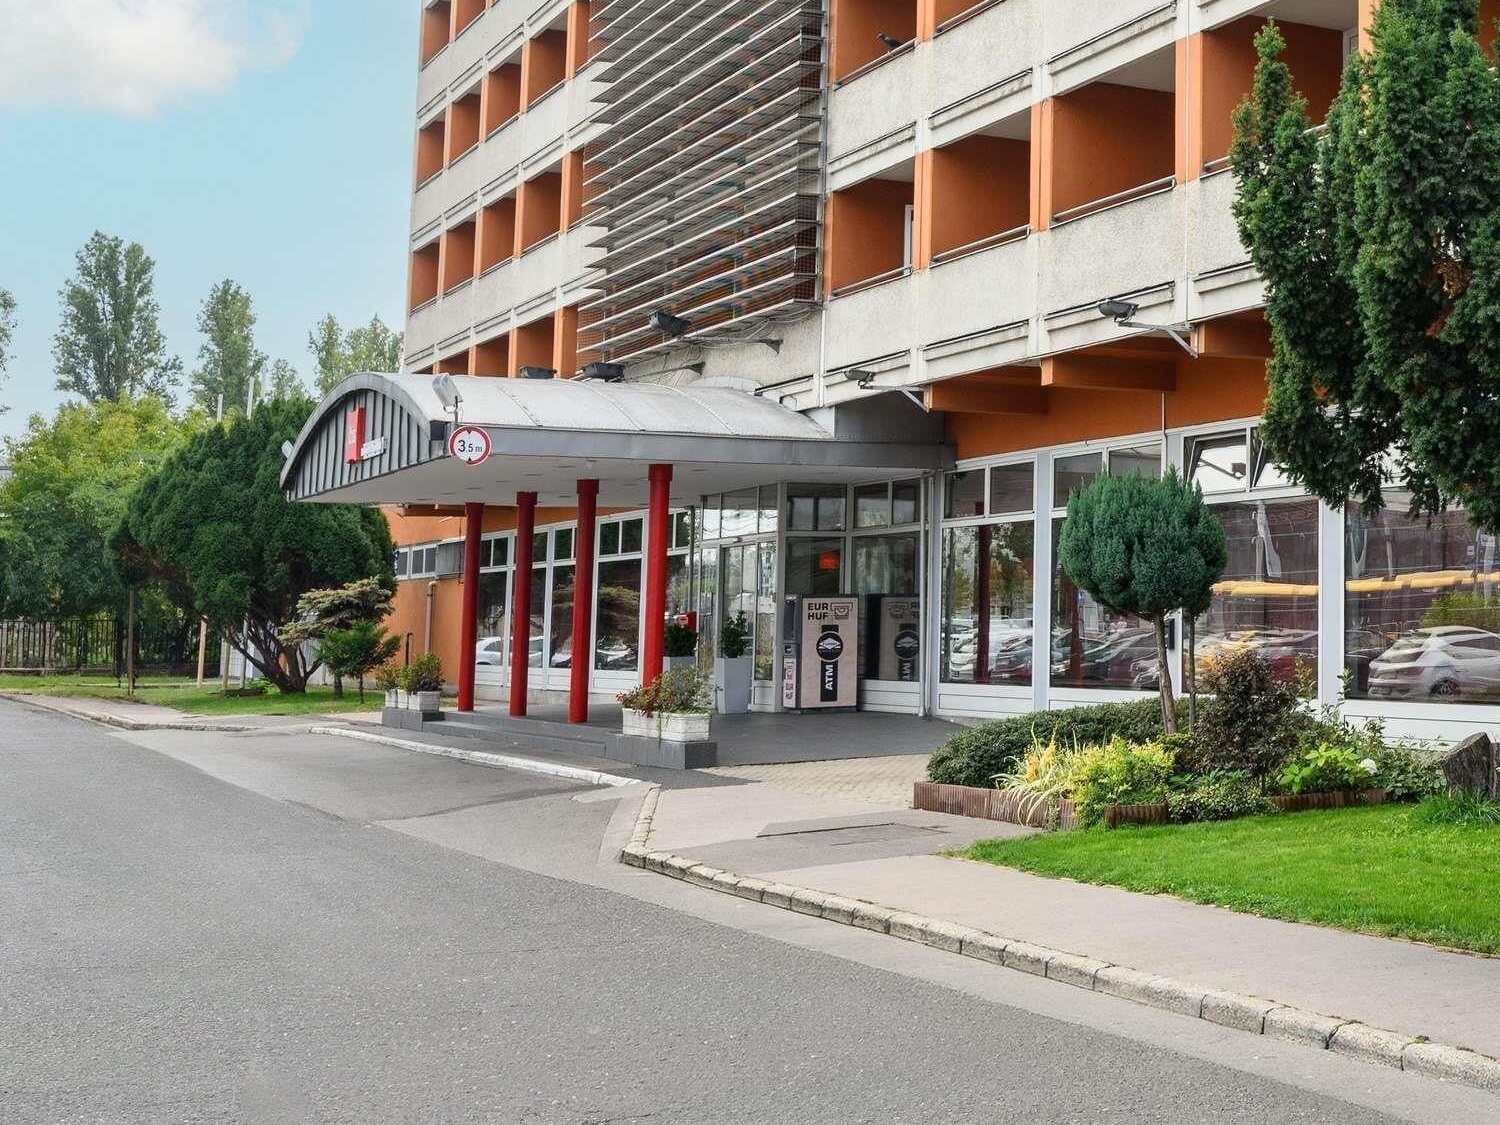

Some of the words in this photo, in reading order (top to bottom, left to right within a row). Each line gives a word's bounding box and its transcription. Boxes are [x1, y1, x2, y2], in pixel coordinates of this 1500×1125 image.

[808, 603, 829, 611] EUR
[808, 612, 829, 620] HUF
[825, 664, 834, 690] ATM
